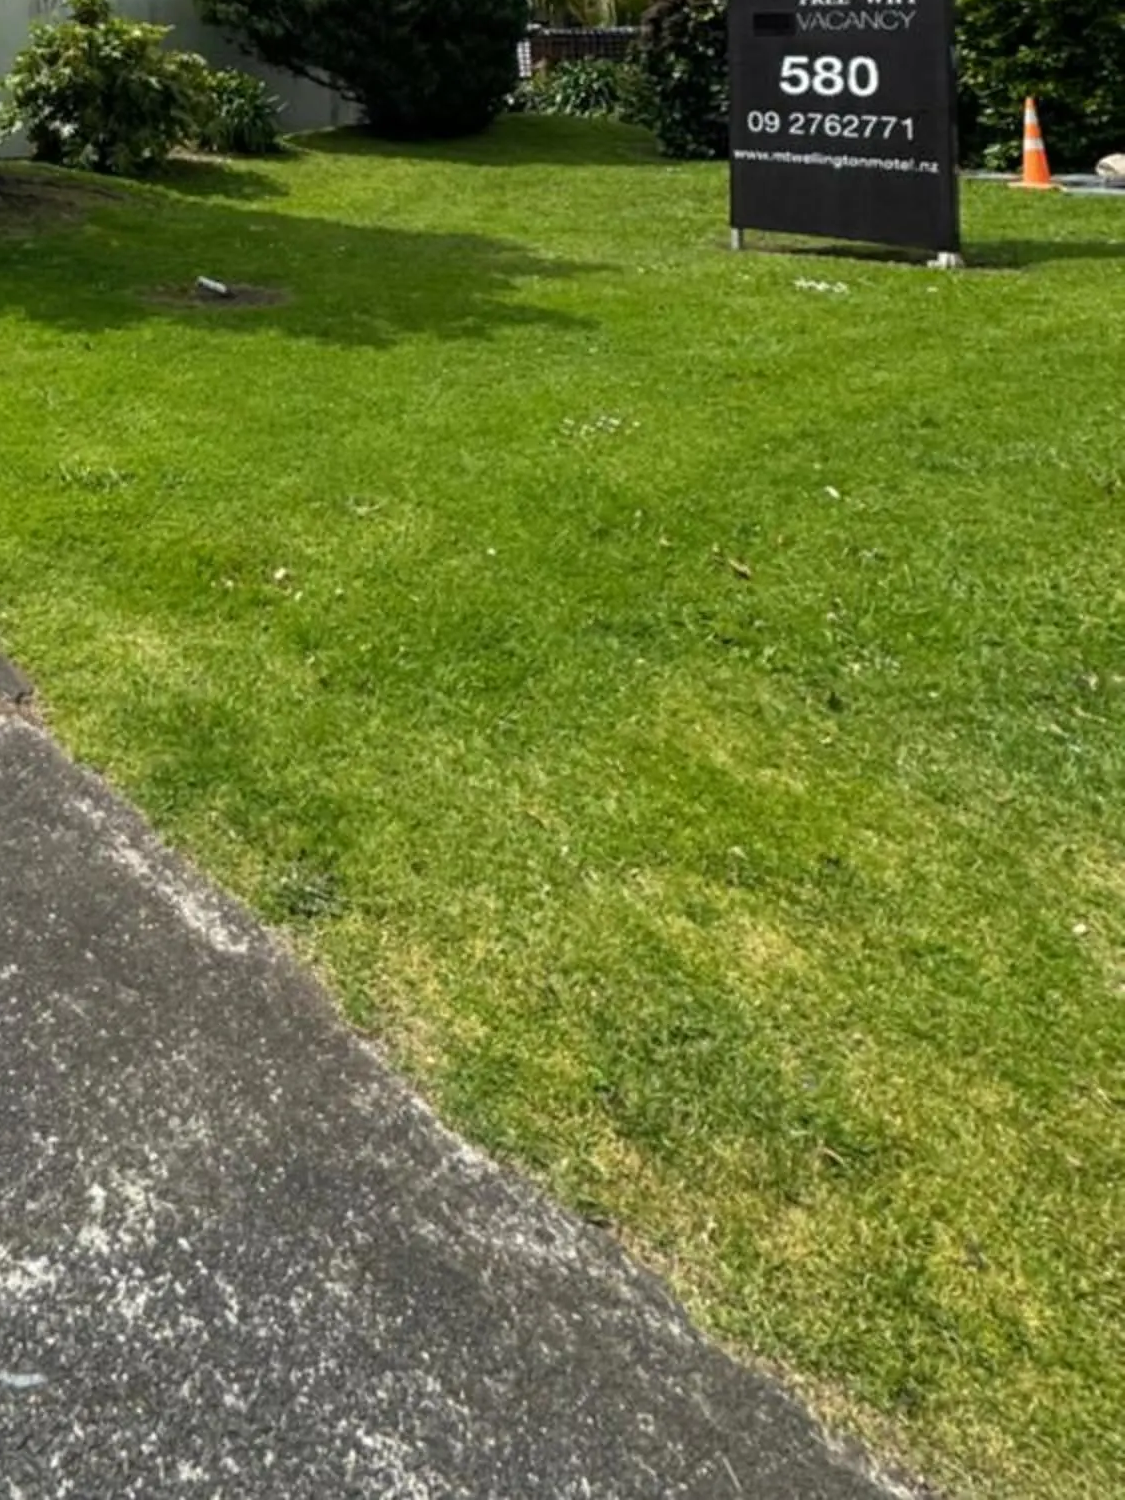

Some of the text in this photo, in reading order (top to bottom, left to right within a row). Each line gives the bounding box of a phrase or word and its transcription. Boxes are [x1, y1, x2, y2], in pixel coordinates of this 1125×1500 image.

[795, 9, 917, 31] VACANCY
[779, 55, 879, 97] 580
[747, 110, 914, 140] 09 2762771
